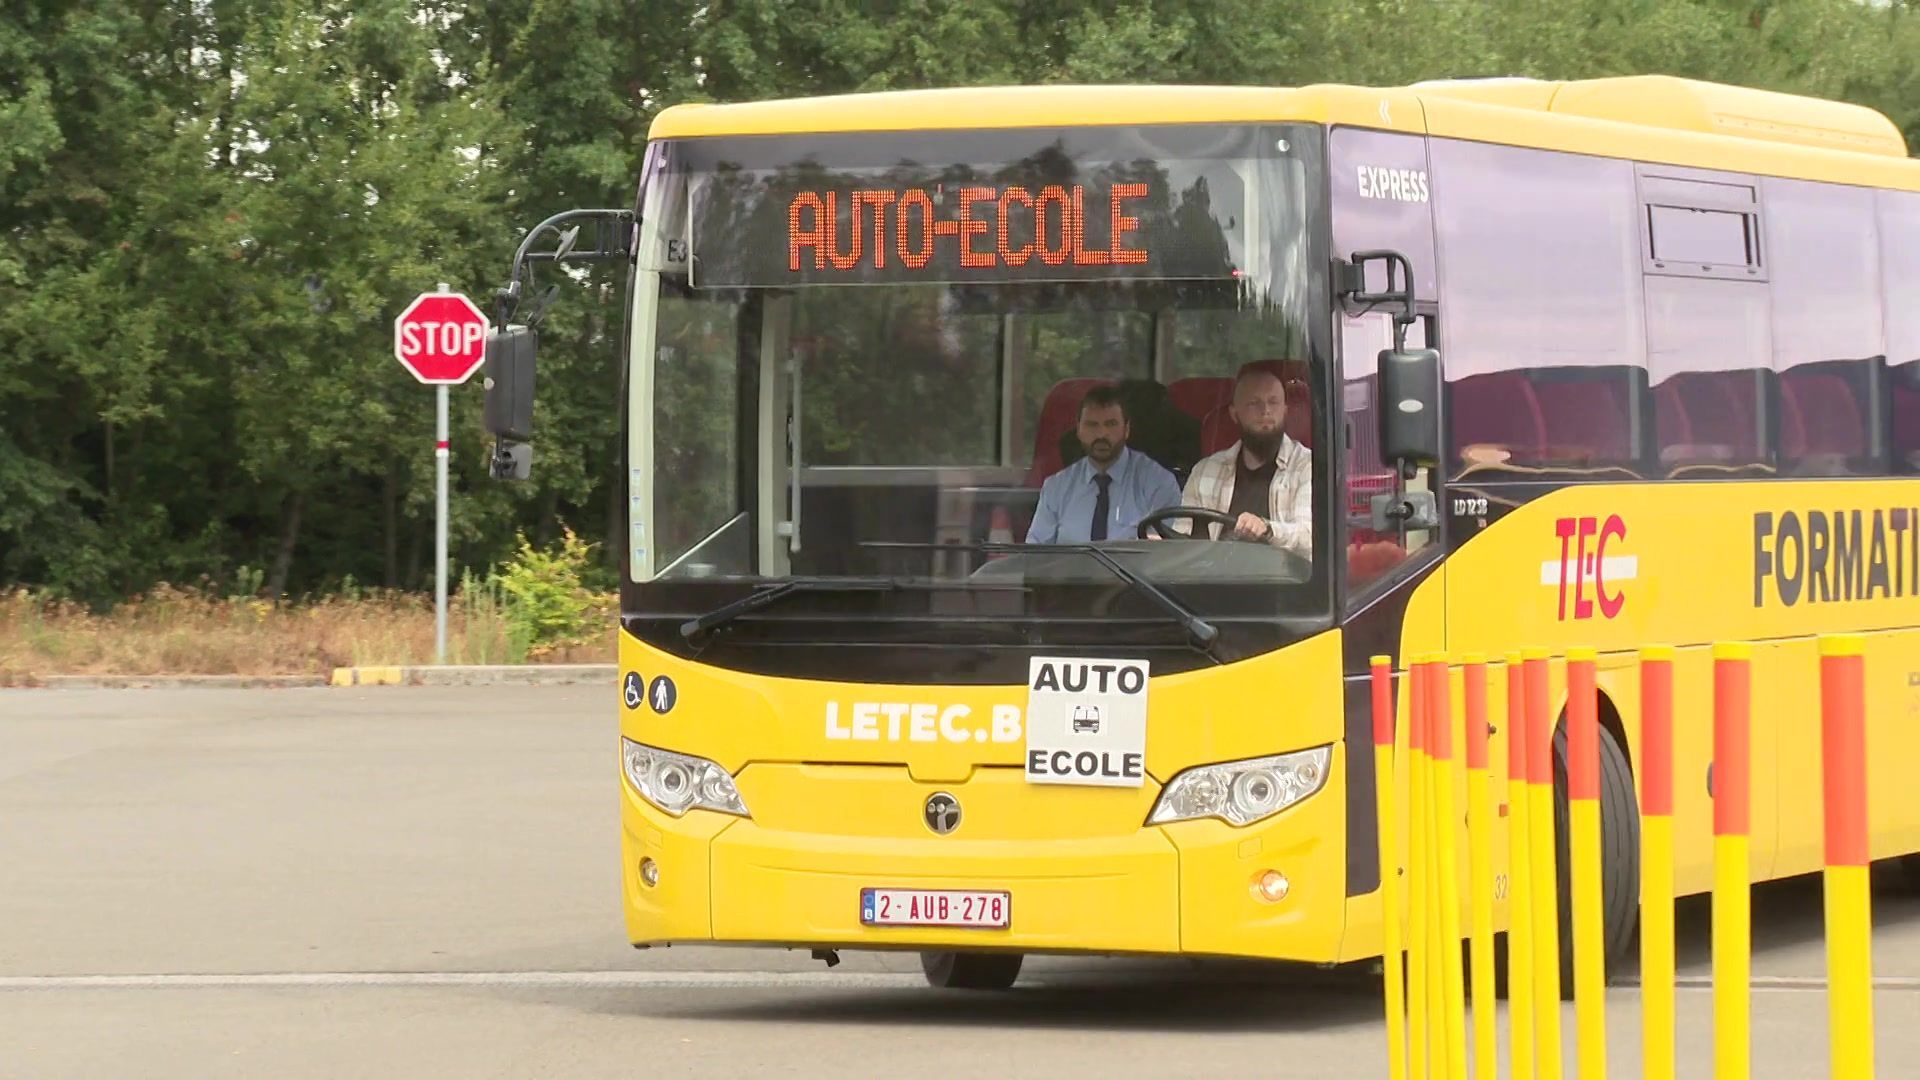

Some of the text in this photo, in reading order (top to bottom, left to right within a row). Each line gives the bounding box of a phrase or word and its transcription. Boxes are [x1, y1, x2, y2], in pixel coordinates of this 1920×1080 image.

[1357, 165, 1429, 202] EXPRESS
[788, 183, 1148, 271] AUTO-ECOLE
[401, 321, 481, 356] STOP
[1555, 513, 1627, 621] TEC
[1033, 663, 1145, 694] AUTO
[826, 701, 1028, 743] LETEC.B
[1028, 750, 1142, 778] ECOLE
[880, 895, 1002, 921] 2-AUB-278
